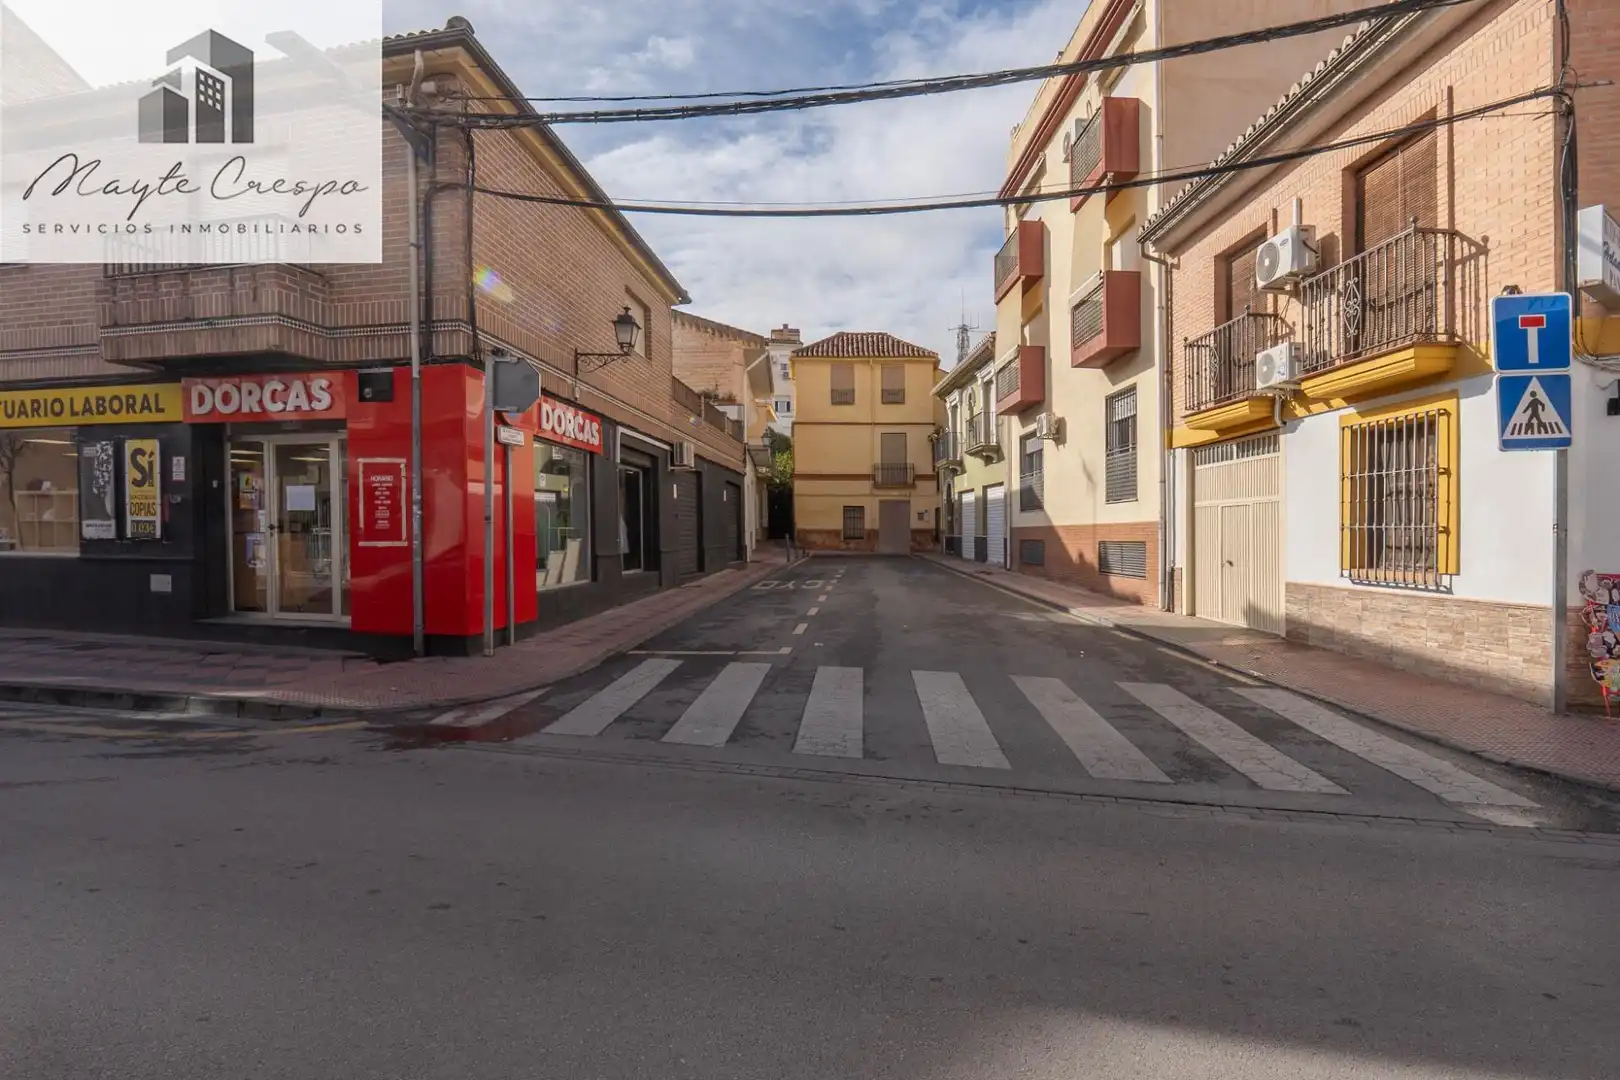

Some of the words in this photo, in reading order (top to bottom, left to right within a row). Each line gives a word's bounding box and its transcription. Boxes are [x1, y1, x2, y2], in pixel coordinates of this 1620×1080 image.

[0, 397, 64, 419] UARIO
[69, 393, 166, 418] LABORAL
[191, 378, 332, 415] DORCAS
[541, 402, 600, 446] DORCAS
[130, 502, 156, 516] COPIAS
